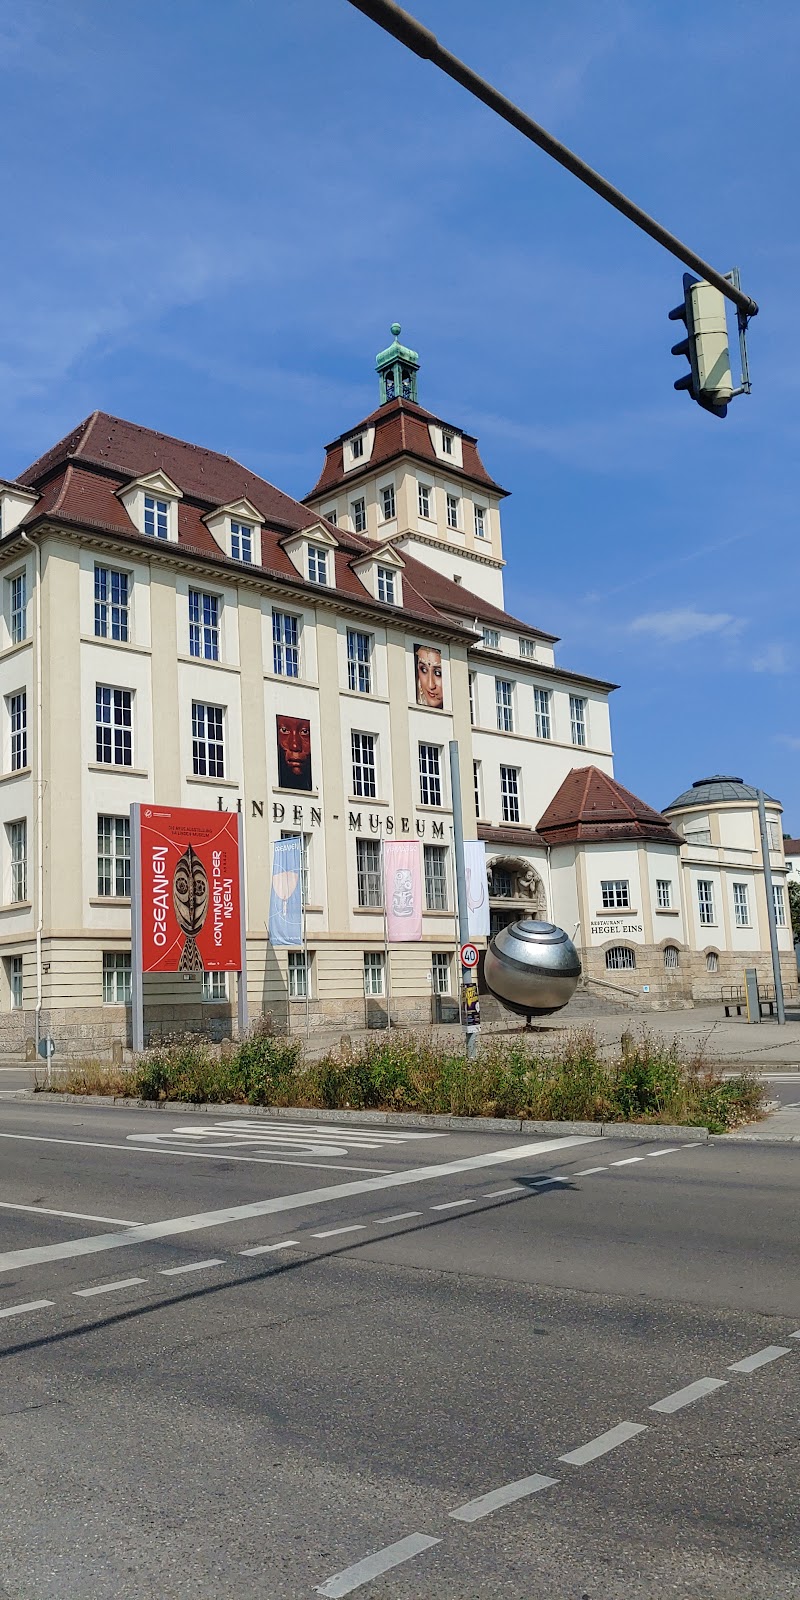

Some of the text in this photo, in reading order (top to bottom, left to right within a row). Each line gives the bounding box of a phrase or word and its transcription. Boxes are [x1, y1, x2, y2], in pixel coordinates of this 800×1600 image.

[152, 846, 169, 946] OZEANIEN
[212, 850, 223, 946] KONTINENT DER
[223, 878, 233, 919] INSELN
[591, 925, 643, 934] HEGEL EINS
[464, 950, 475, 961] 40
